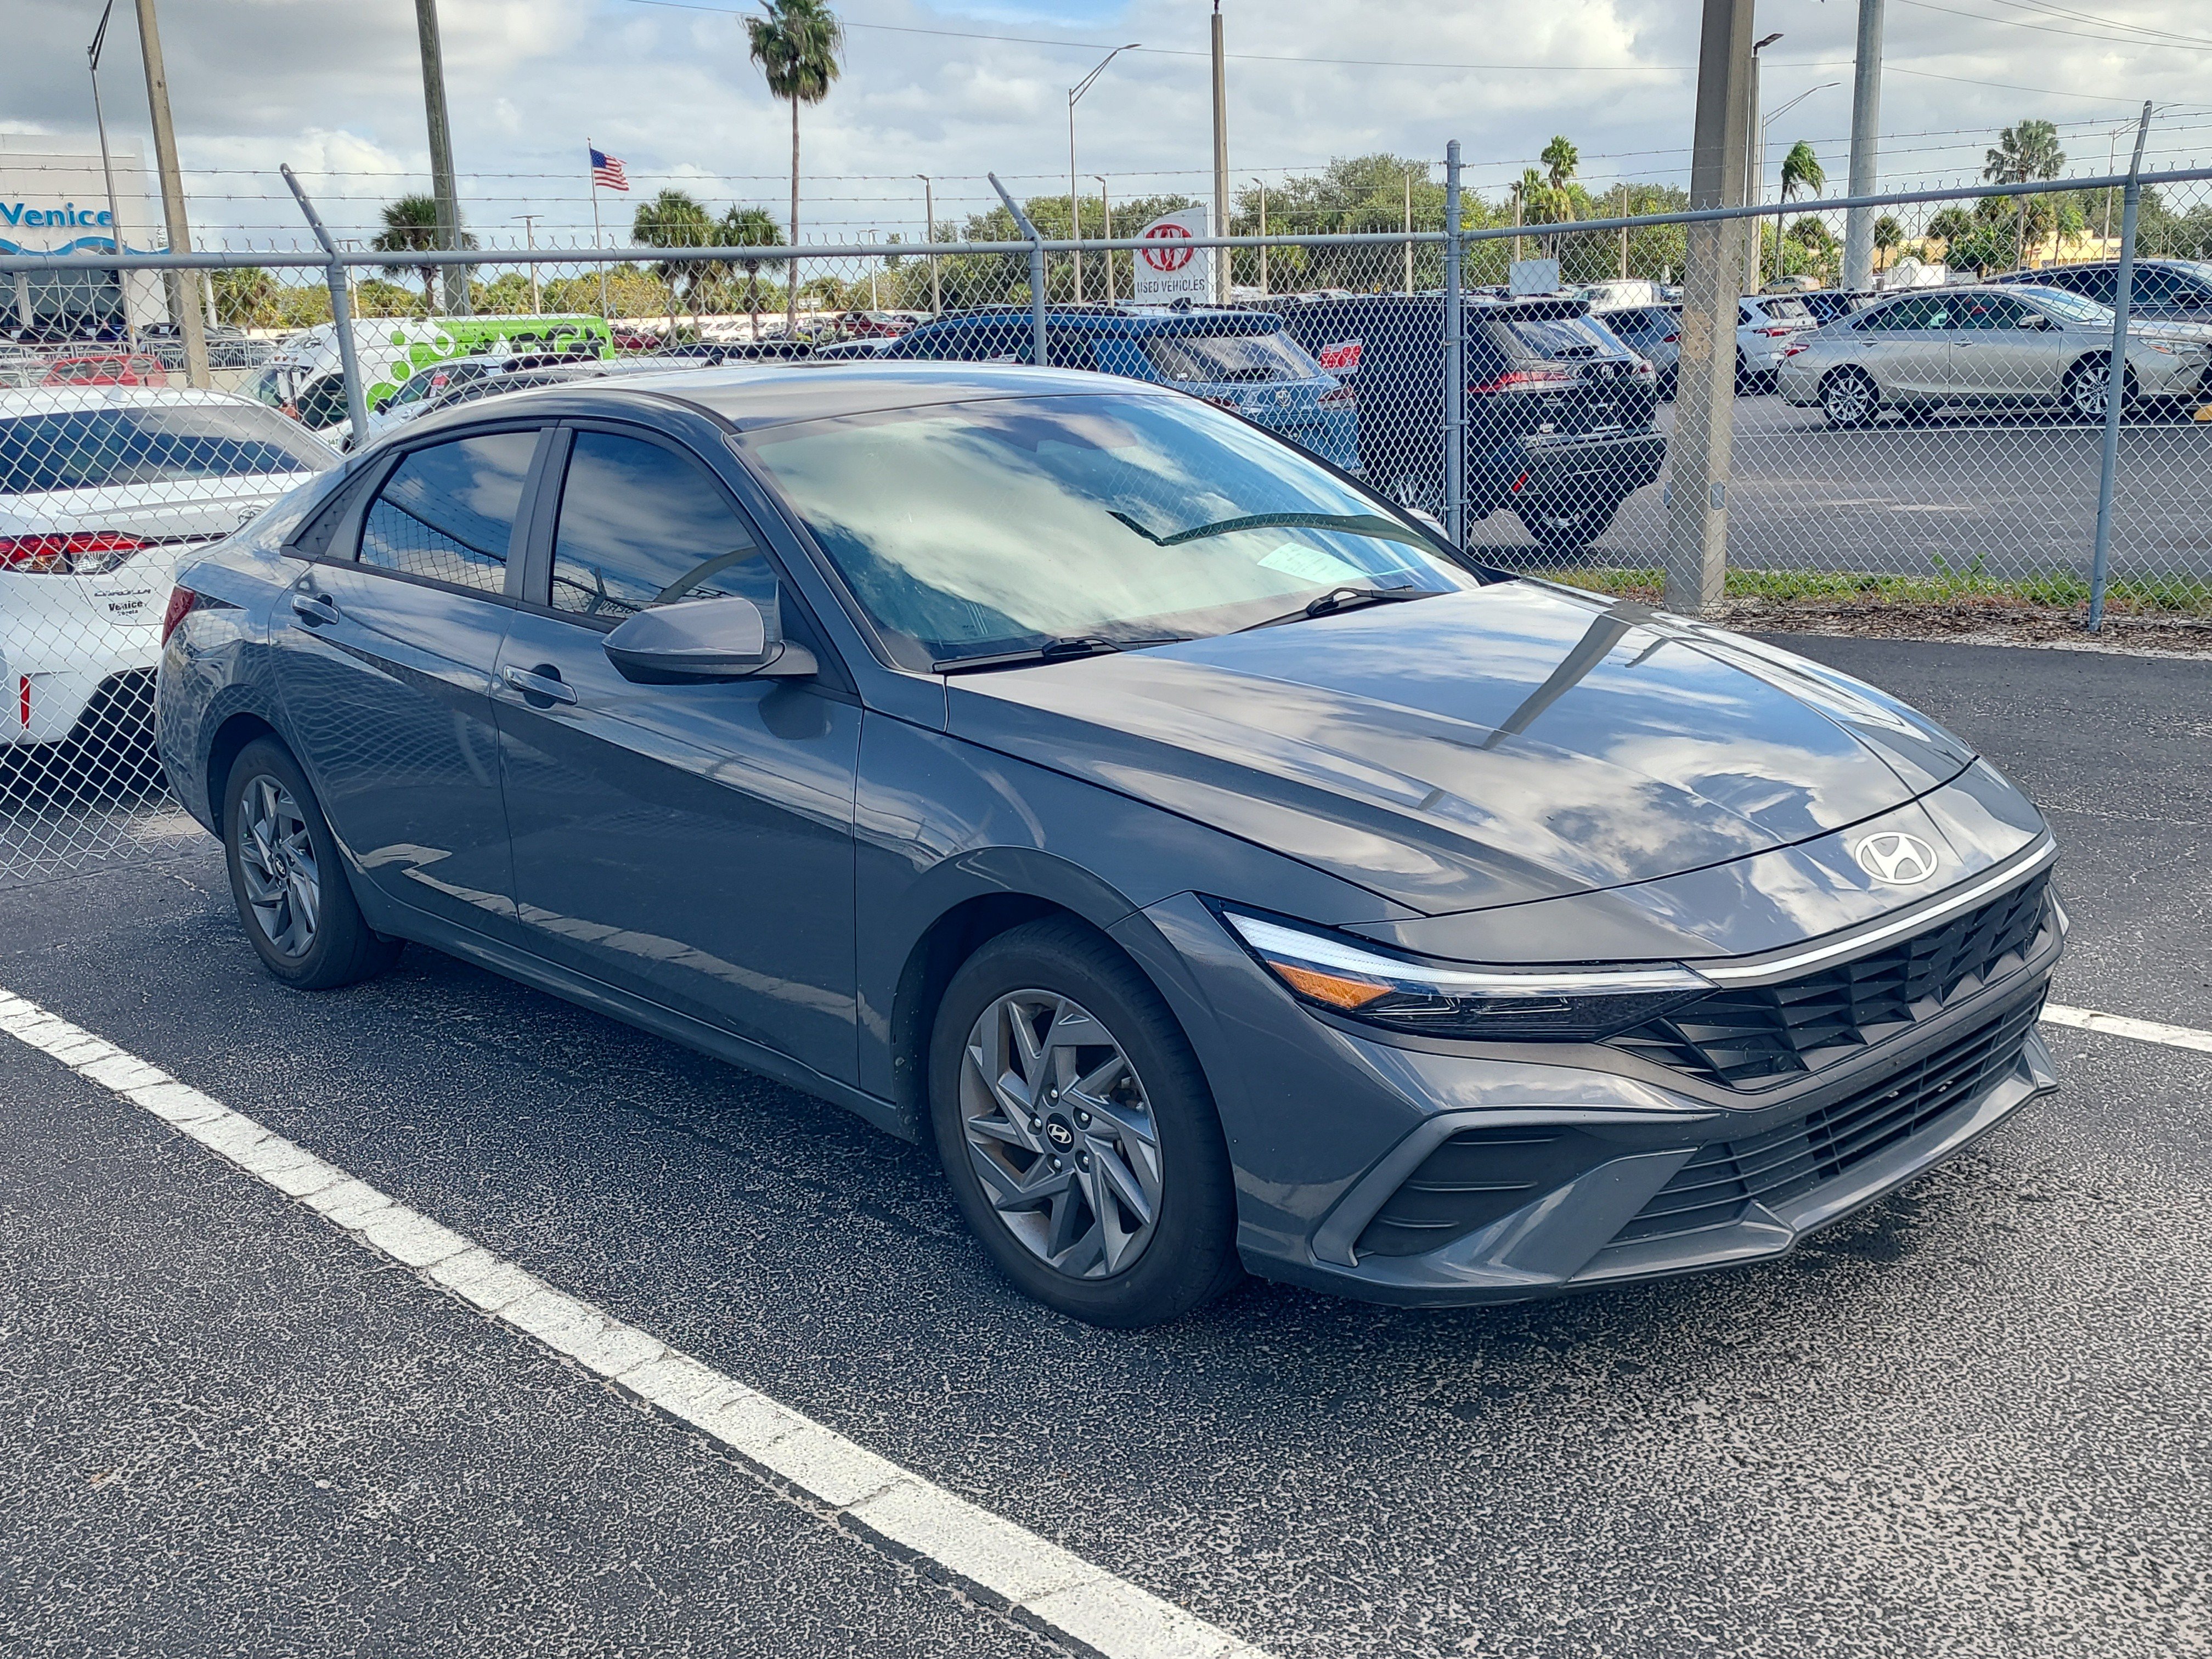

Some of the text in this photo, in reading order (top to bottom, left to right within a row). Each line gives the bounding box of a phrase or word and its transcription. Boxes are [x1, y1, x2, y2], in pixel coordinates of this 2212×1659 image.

[0, 202, 112, 227] Venice
[1137, 278, 1205, 294] USED VEHICLES
[108, 600, 143, 612] Venice
